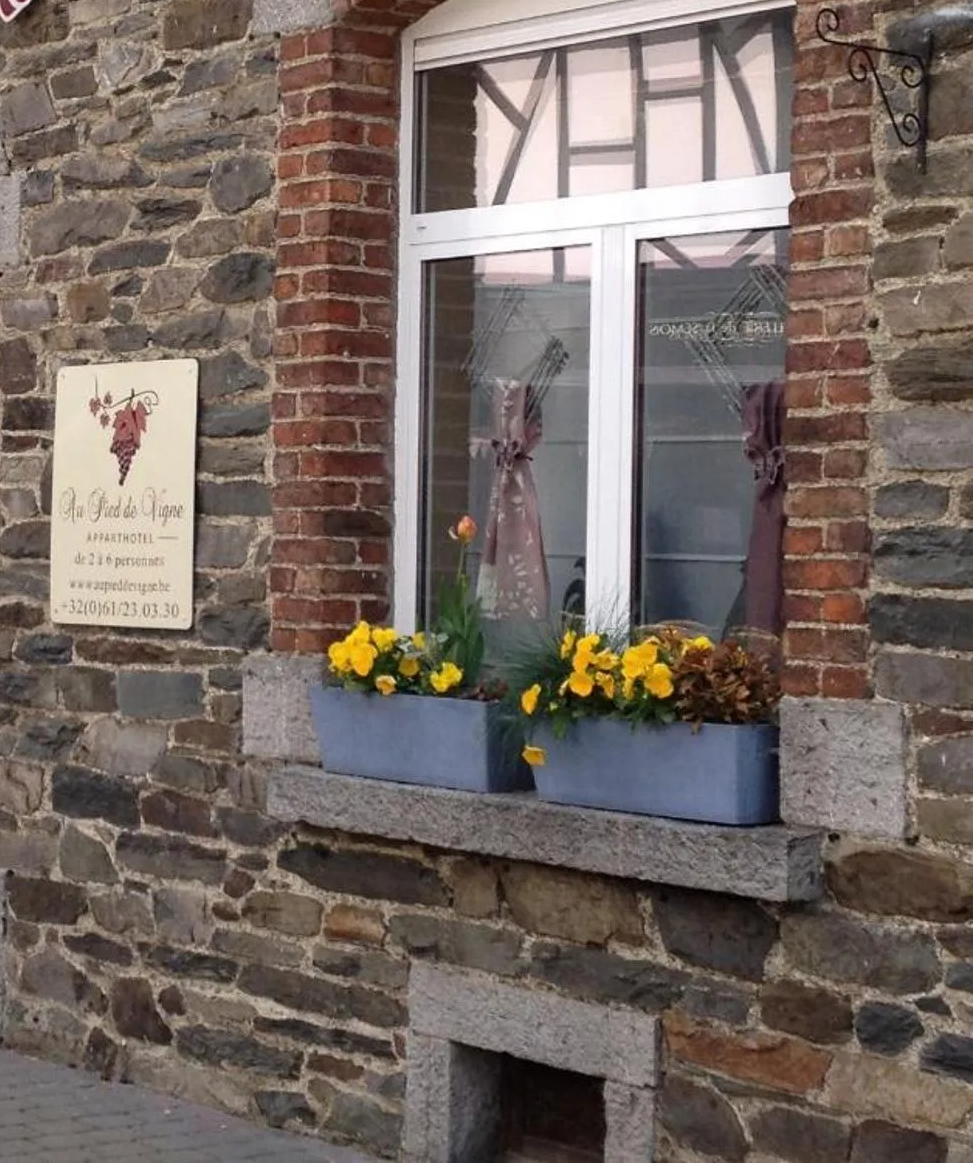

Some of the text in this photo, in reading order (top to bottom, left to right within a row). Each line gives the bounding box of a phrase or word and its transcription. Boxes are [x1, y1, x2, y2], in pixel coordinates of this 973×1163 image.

[59, 487, 184, 526] Au Pied de Vigne
[86, 532, 155, 544] APPARTHOTEL
[74, 551, 86, 566] de
[89, 552, 95, 566] 2
[106, 552, 112, 566] 6
[115, 556, 165, 569] personnes
